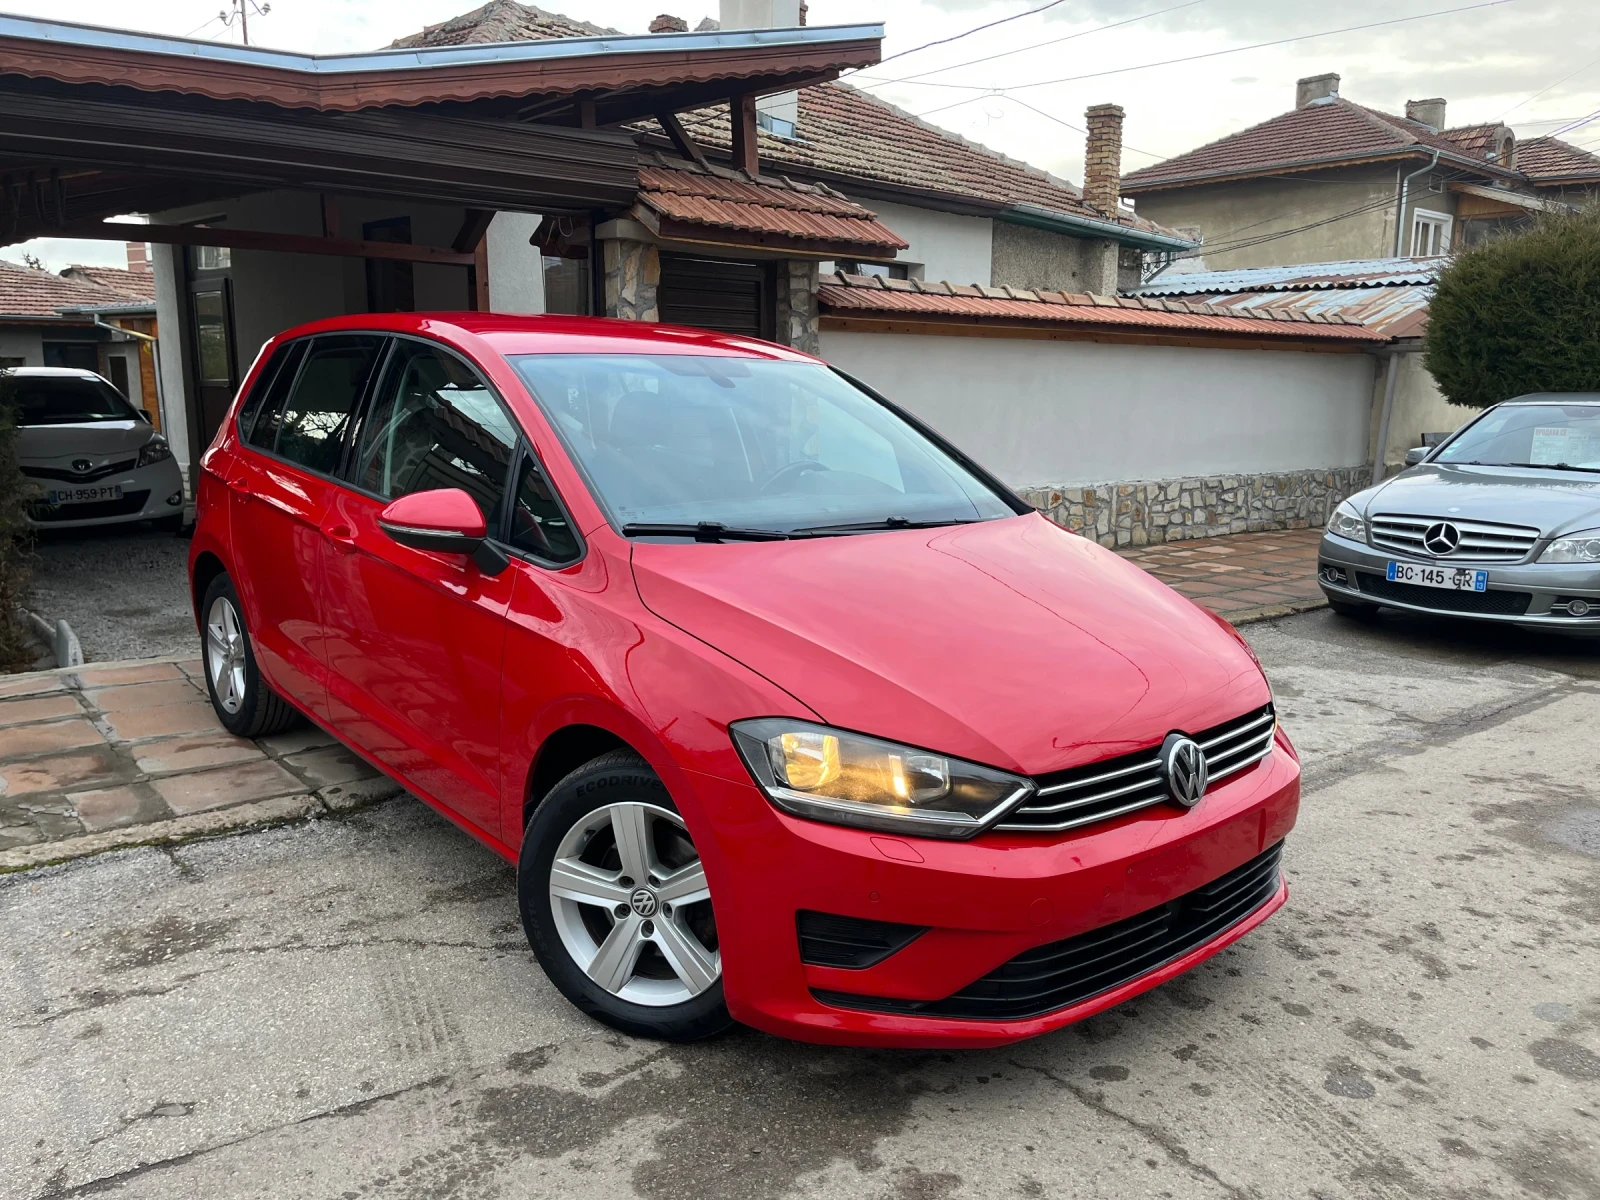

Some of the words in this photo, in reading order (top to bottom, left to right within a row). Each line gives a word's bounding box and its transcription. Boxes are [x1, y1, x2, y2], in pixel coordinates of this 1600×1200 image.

[1560, 428, 1568, 437] СЕ
[57, 487, 114, 501] CH-959-PT
[575, 775, 666, 798] ECODRIVE
